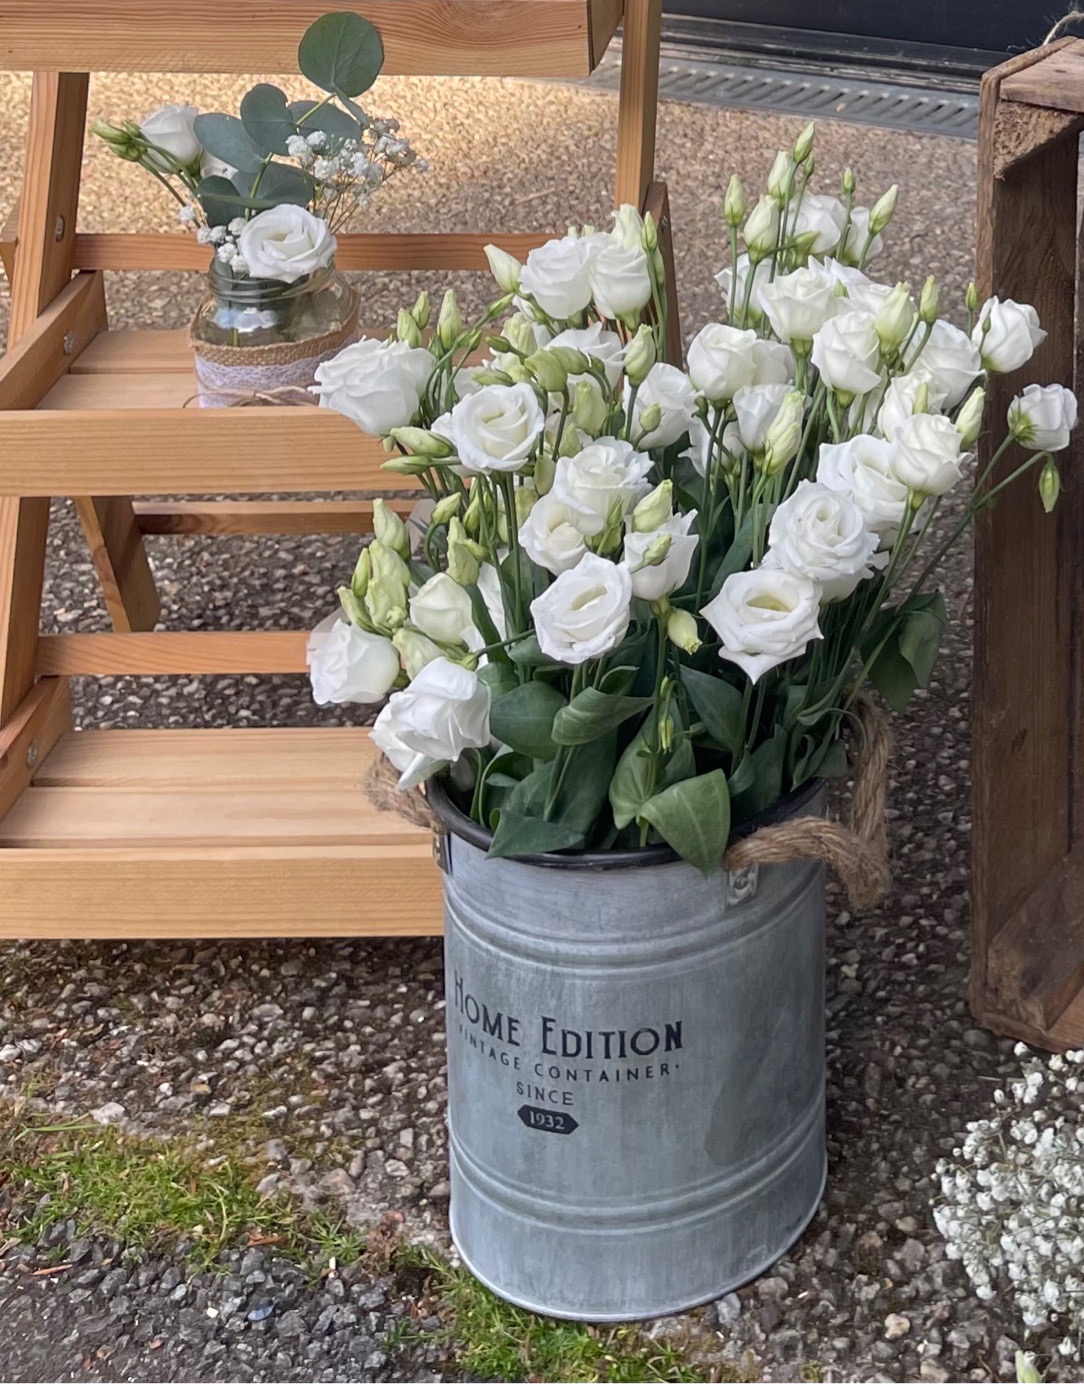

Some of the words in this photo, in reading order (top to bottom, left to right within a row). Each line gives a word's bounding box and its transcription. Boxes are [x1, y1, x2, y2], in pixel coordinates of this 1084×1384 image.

[454, 969, 521, 1047] HOME
[541, 1016, 683, 1060] EDITION
[458, 1023, 521, 1071] VINTAGE
[516, 1081, 574, 1106] SINCE
[529, 1110, 566, 1130] 1932
